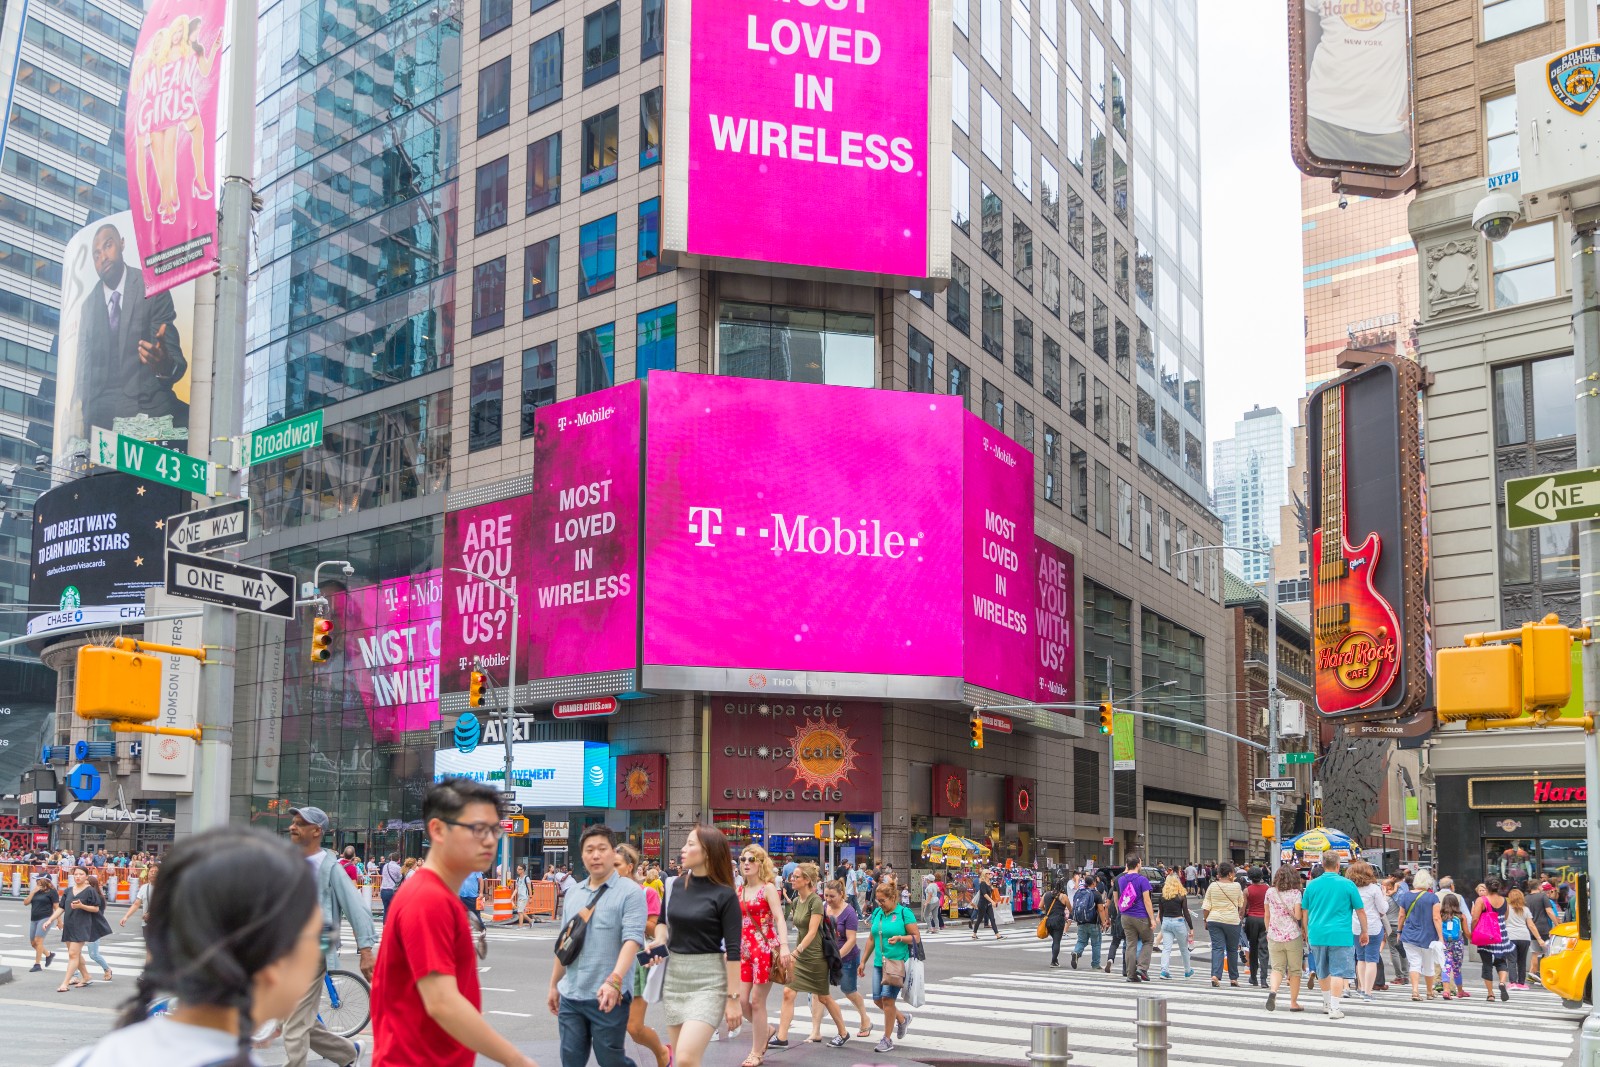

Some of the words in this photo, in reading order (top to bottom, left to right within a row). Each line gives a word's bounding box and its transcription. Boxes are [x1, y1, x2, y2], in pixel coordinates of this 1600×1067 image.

[748, 14, 881, 65] LOVED
[1562, 48, 1595, 65] POLICE
[141, 60, 198, 97] MEAN
[794, 72, 833, 112] IN
[1552, 85, 1565, 99] CITY
[1564, 98, 1574, 107] OF
[1586, 87, 1600, 104] NEW
[136, 91, 195, 133] GIRLS
[708, 114, 914, 173] WIRELESS
[1488, 171, 1519, 188] NYPD
[254, 420, 319, 458] Broadway
[124, 441, 144, 471] W
[156, 453, 181, 482] 43
[192, 463, 206, 481] St
[559, 480, 612, 511] MOST
[1534, 486, 1584, 510] ONE
[44, 523, 57, 543] TWO
[58, 518, 85, 539] GREAT
[86, 512, 118, 532] WAYS
[178, 524, 201, 545] ONE
[212, 515, 238, 536] WAY
[462, 514, 512, 553] ARE
[554, 512, 616, 543] LOVED
[985, 508, 1016, 542] MOST
[38, 549, 46, 565] TO
[46, 541, 64, 562] EARN
[64, 537, 91, 555] MORE
[93, 532, 130, 552] STARS
[462, 546, 512, 582] YOU
[574, 548, 593, 572] IN
[982, 537, 1018, 572] LOVED
[46, 559, 106, 576] starbucks.com/visacards
[1038, 554, 1066, 590] ARE
[188, 569, 224, 592] ONE
[242, 580, 277, 601] WAY
[456, 576, 517, 615] WITH
[538, 574, 631, 609] WIRELESS
[996, 574, 1007, 597] IN
[1038, 580, 1066, 618] YOU
[47, 612, 73, 626] CHASE
[462, 610, 507, 645] US?
[973, 594, 1027, 635] WIRELESS
[1036, 608, 1070, 647] WITH
[171, 619, 183, 671] RETERS
[1040, 642, 1065, 672] US?
[1318, 645, 1354, 670] Hard
[1358, 638, 1395, 666] Rock
[1346, 668, 1368, 680] CAFE
[166, 673, 179, 727] HOMSON
[559, 704, 583, 714] BRANDED
[584, 702, 612, 712] CITIES.com
[802, 703, 843, 718] café
[483, 718, 531, 743] AT&T
[1362, 726, 1404, 734] SPECTACOLOR
[802, 745, 843, 760] café
[511, 769, 556, 780] OVEMENT
[802, 787, 843, 801] café
[89, 807, 162, 822] CHASE
[545, 822, 568, 830] BELLA
[1549, 819, 1588, 828] ROCK
